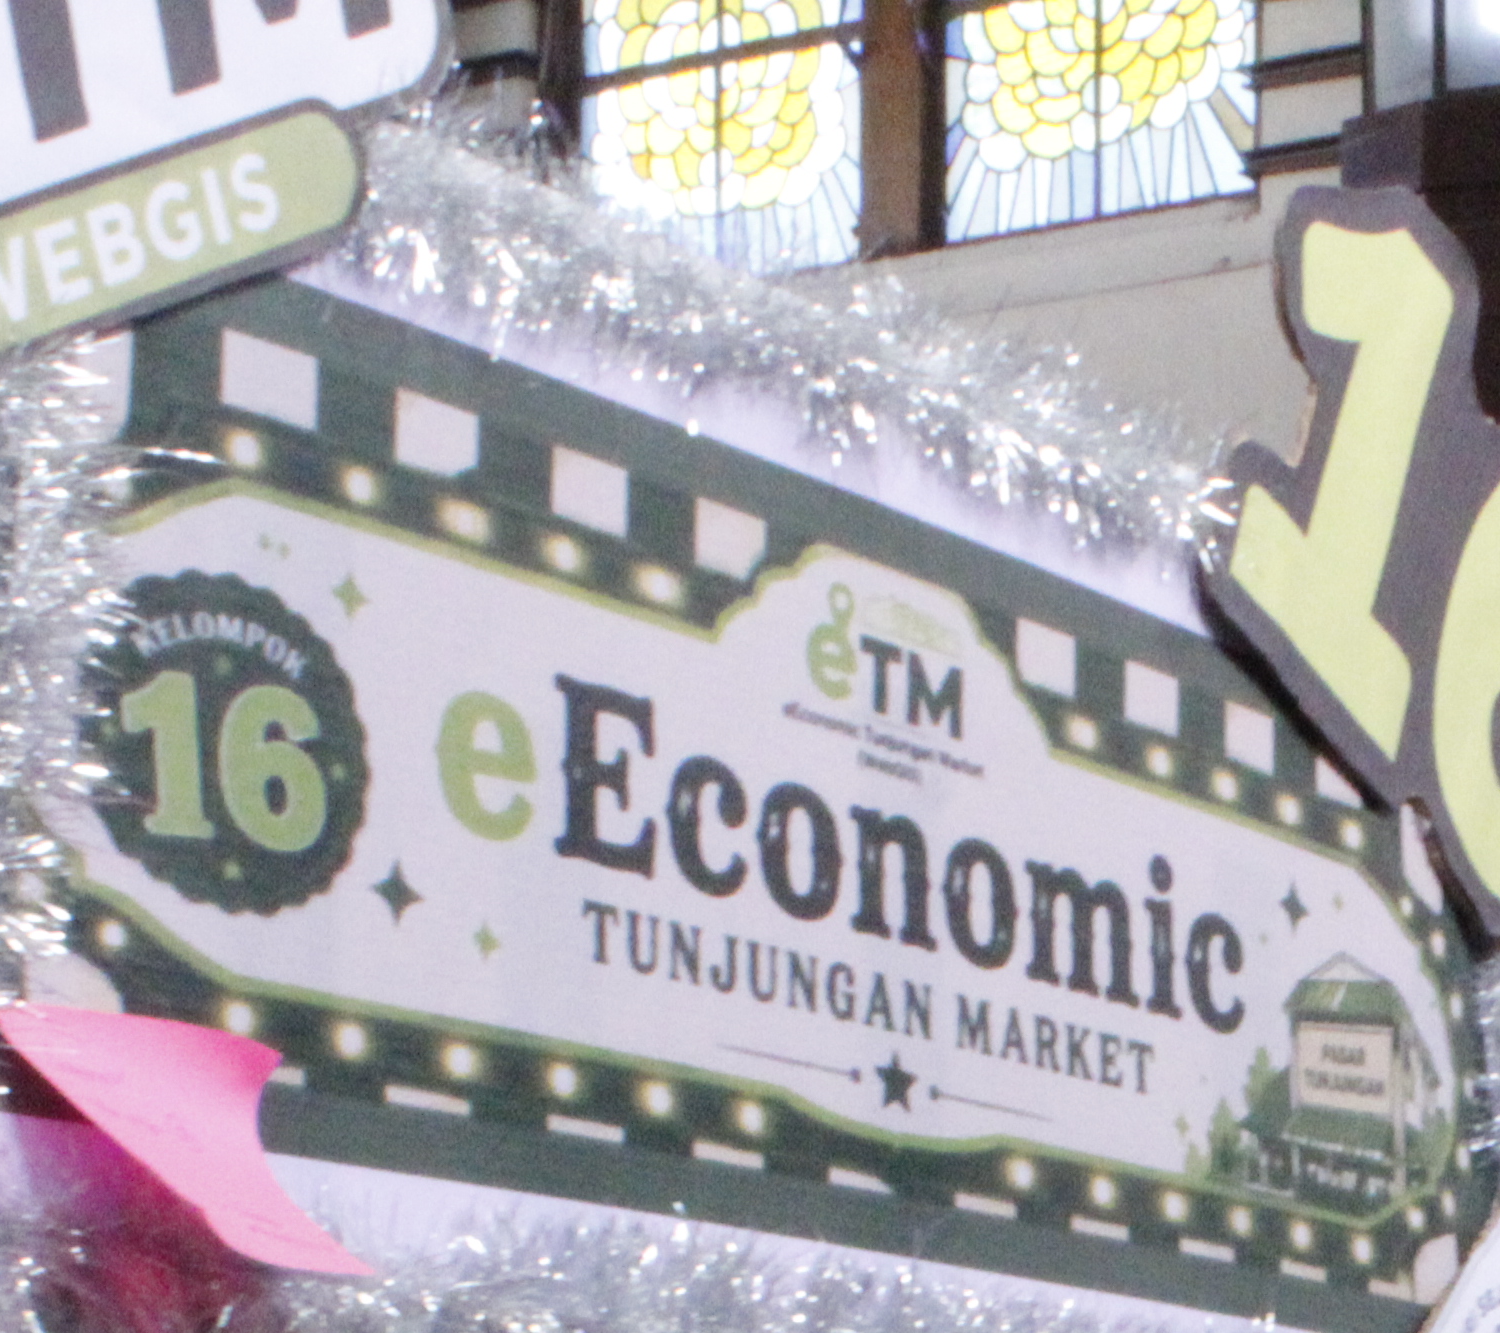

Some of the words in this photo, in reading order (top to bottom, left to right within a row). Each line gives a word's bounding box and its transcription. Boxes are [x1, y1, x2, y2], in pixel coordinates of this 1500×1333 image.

[120, 670, 328, 852] 16
[435, 672, 1245, 1034] eEconomic
[582, 900, 932, 1041] TUNJUNGAN
[955, 992, 1156, 1095] MARKET
